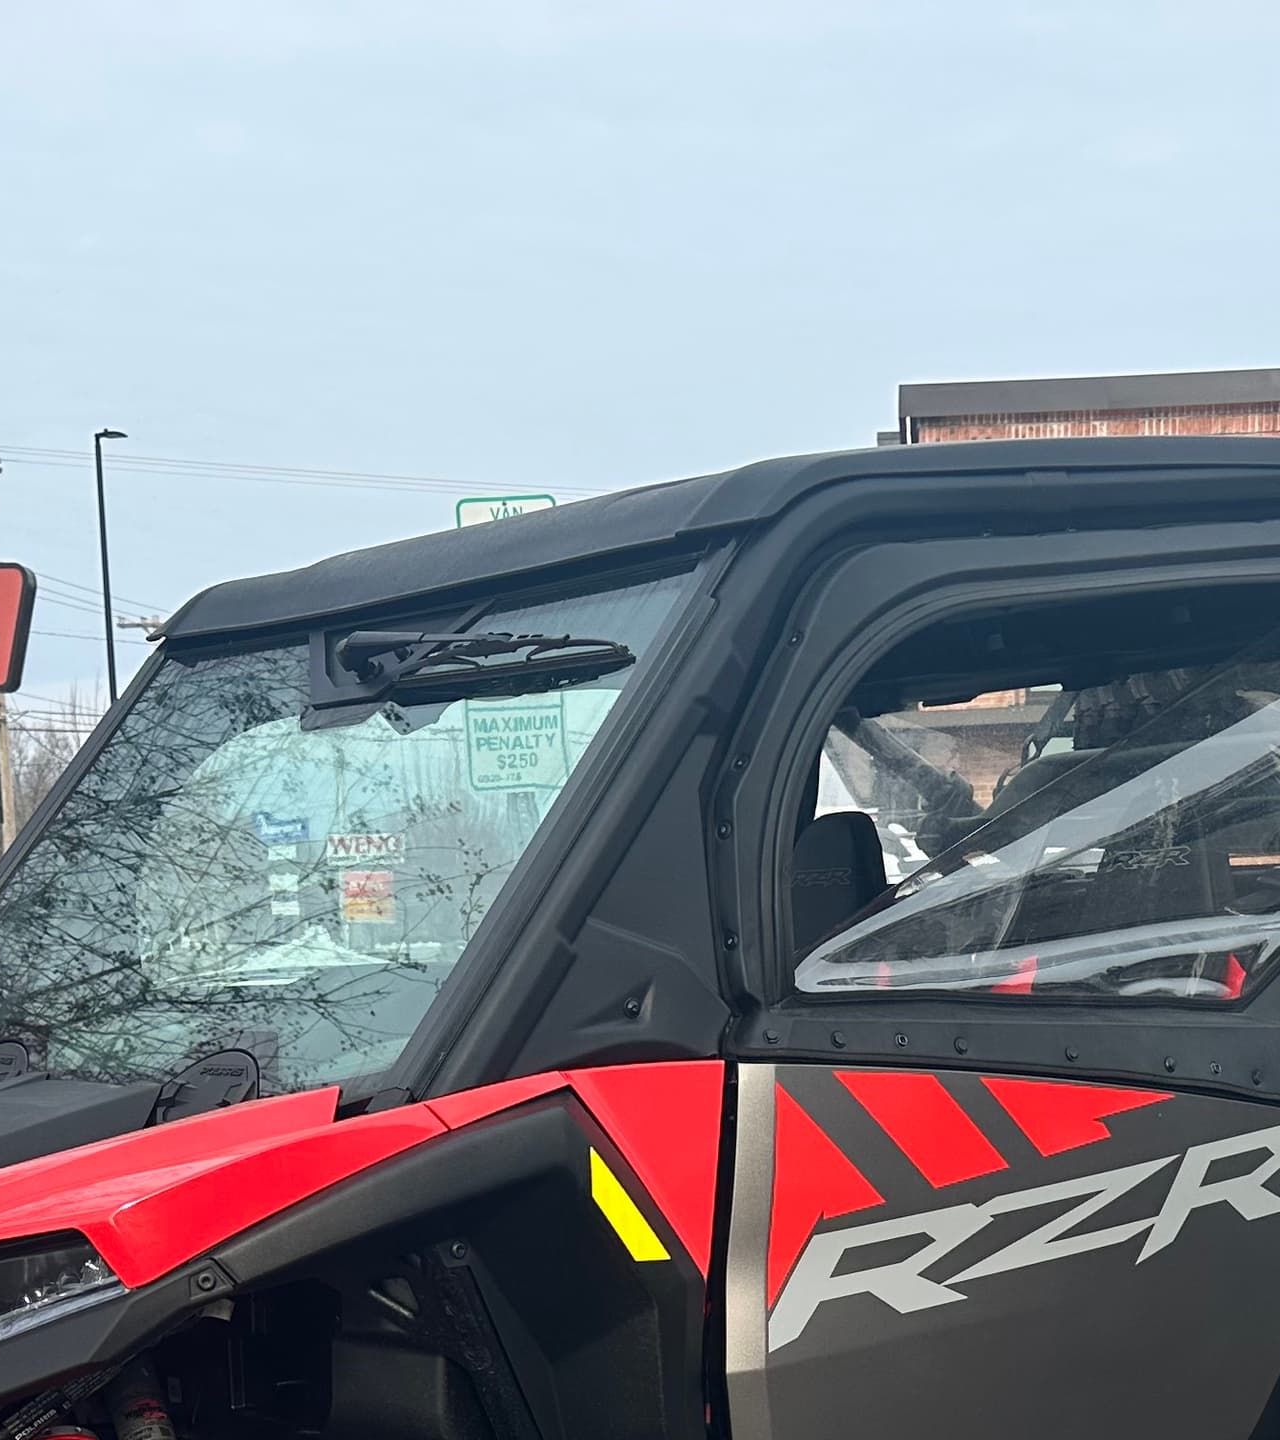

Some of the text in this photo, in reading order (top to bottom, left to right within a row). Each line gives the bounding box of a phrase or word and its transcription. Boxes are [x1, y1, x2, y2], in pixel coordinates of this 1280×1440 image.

[473, 715, 558, 733] MAXIMUM
[476, 733, 556, 751] PENALTY
[497, 752, 538, 769] $250
